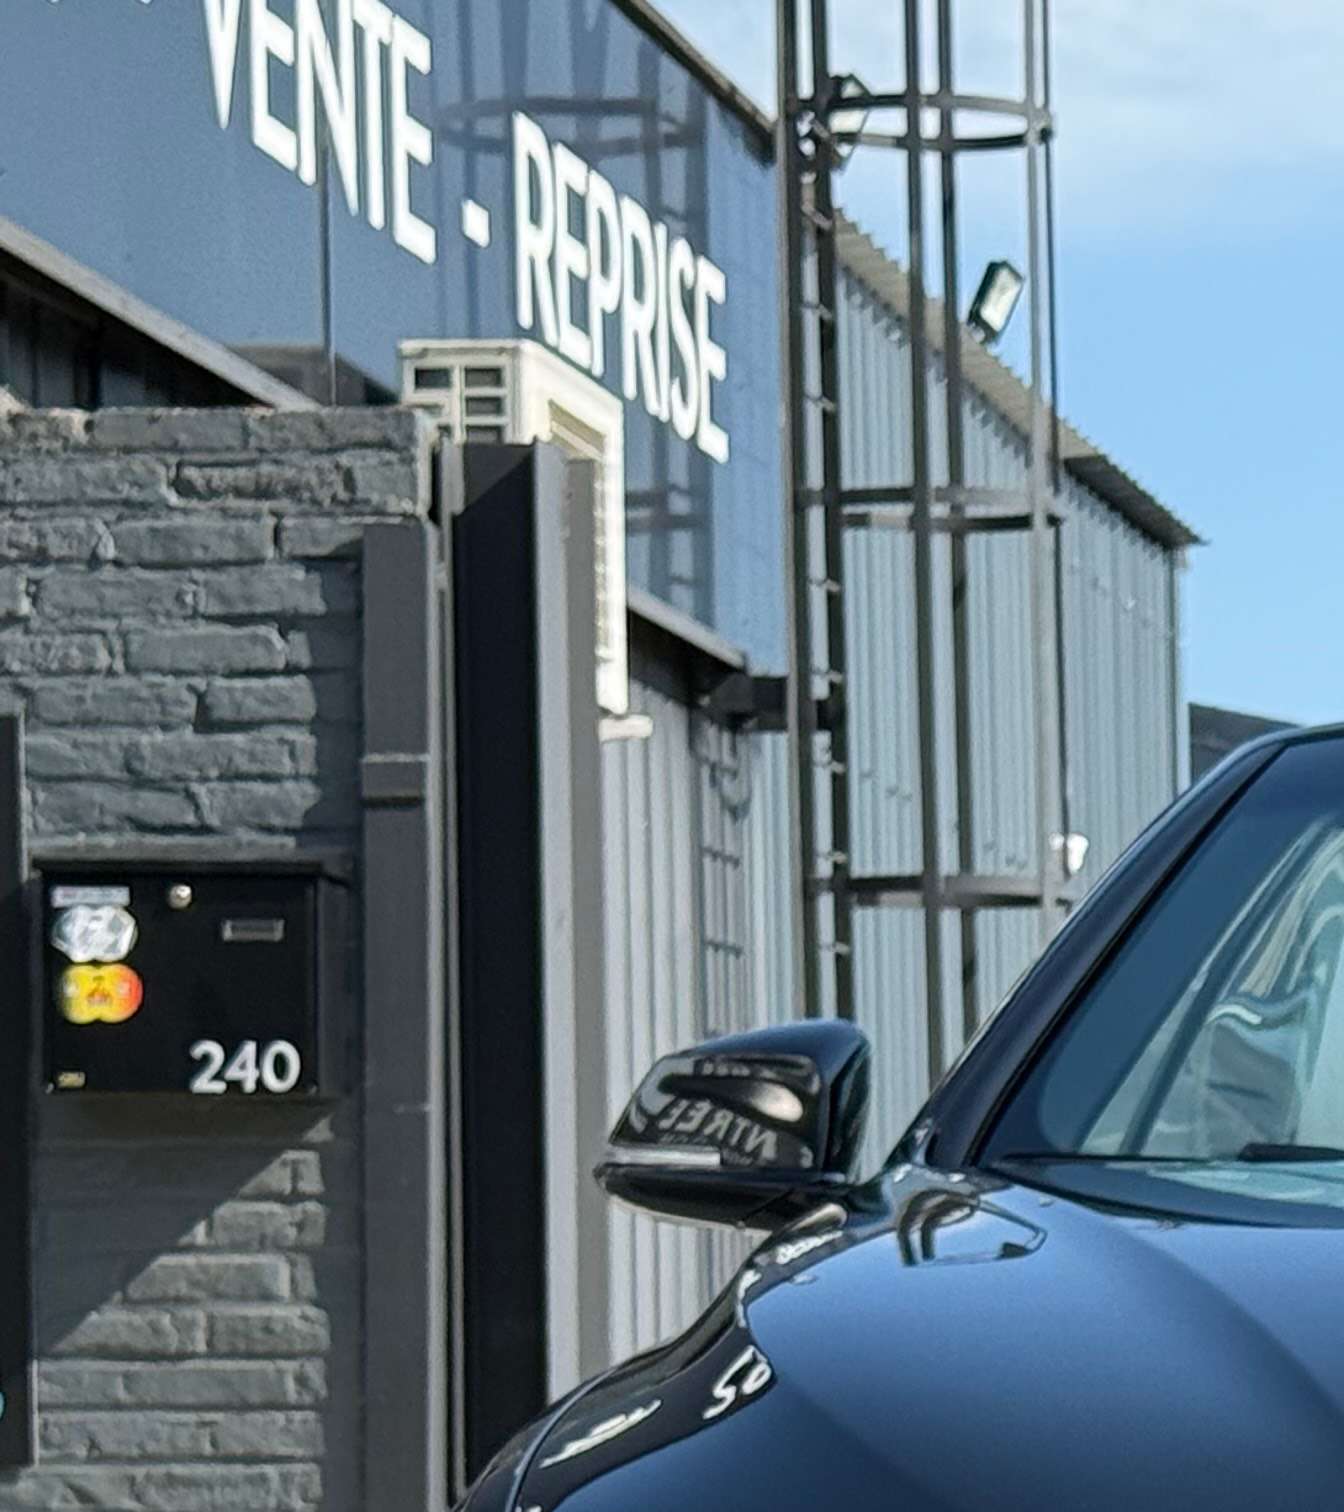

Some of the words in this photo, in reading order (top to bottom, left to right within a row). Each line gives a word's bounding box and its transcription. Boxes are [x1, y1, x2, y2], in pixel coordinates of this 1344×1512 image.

[204, 0, 438, 264] VENTE
[512, 110, 730, 464] REPRISE
[189, 1039, 301, 1094] 240
